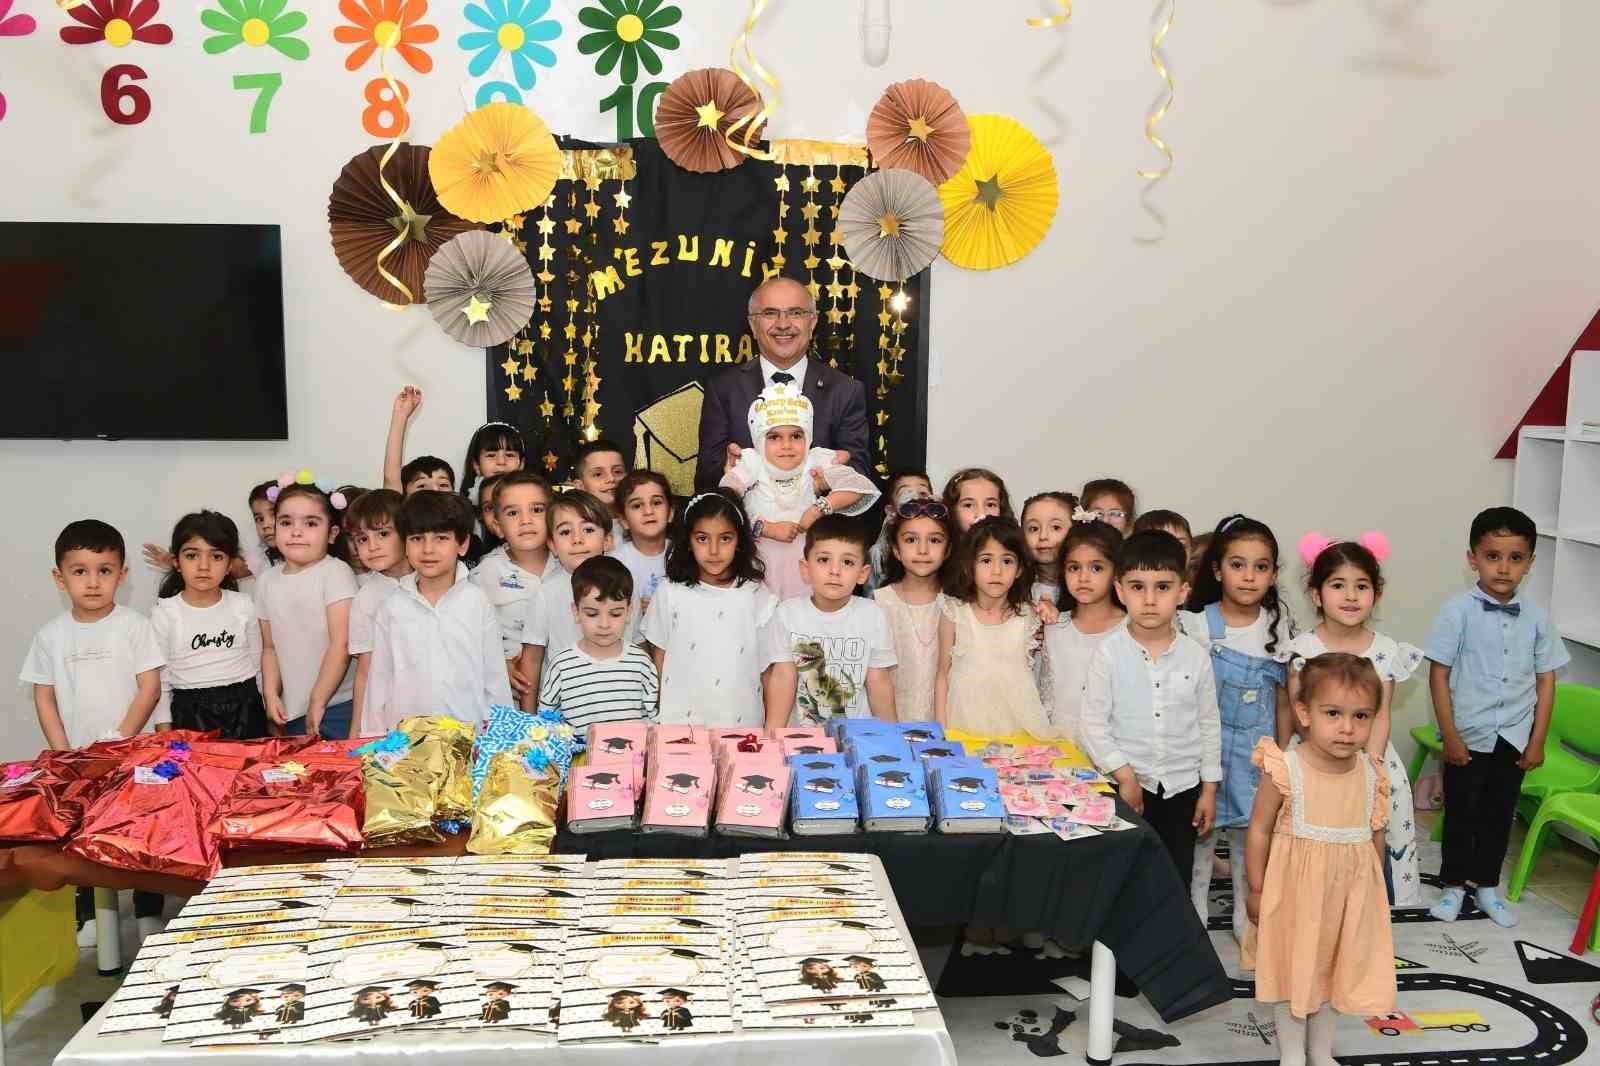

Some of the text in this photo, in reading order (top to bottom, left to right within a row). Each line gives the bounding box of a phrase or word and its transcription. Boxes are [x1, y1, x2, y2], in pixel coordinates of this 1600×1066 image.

[101, 64, 152, 125] 6
[232, 73, 282, 134] 7
[362, 78, 410, 138] 8
[191, 629, 236, 650] Christy
